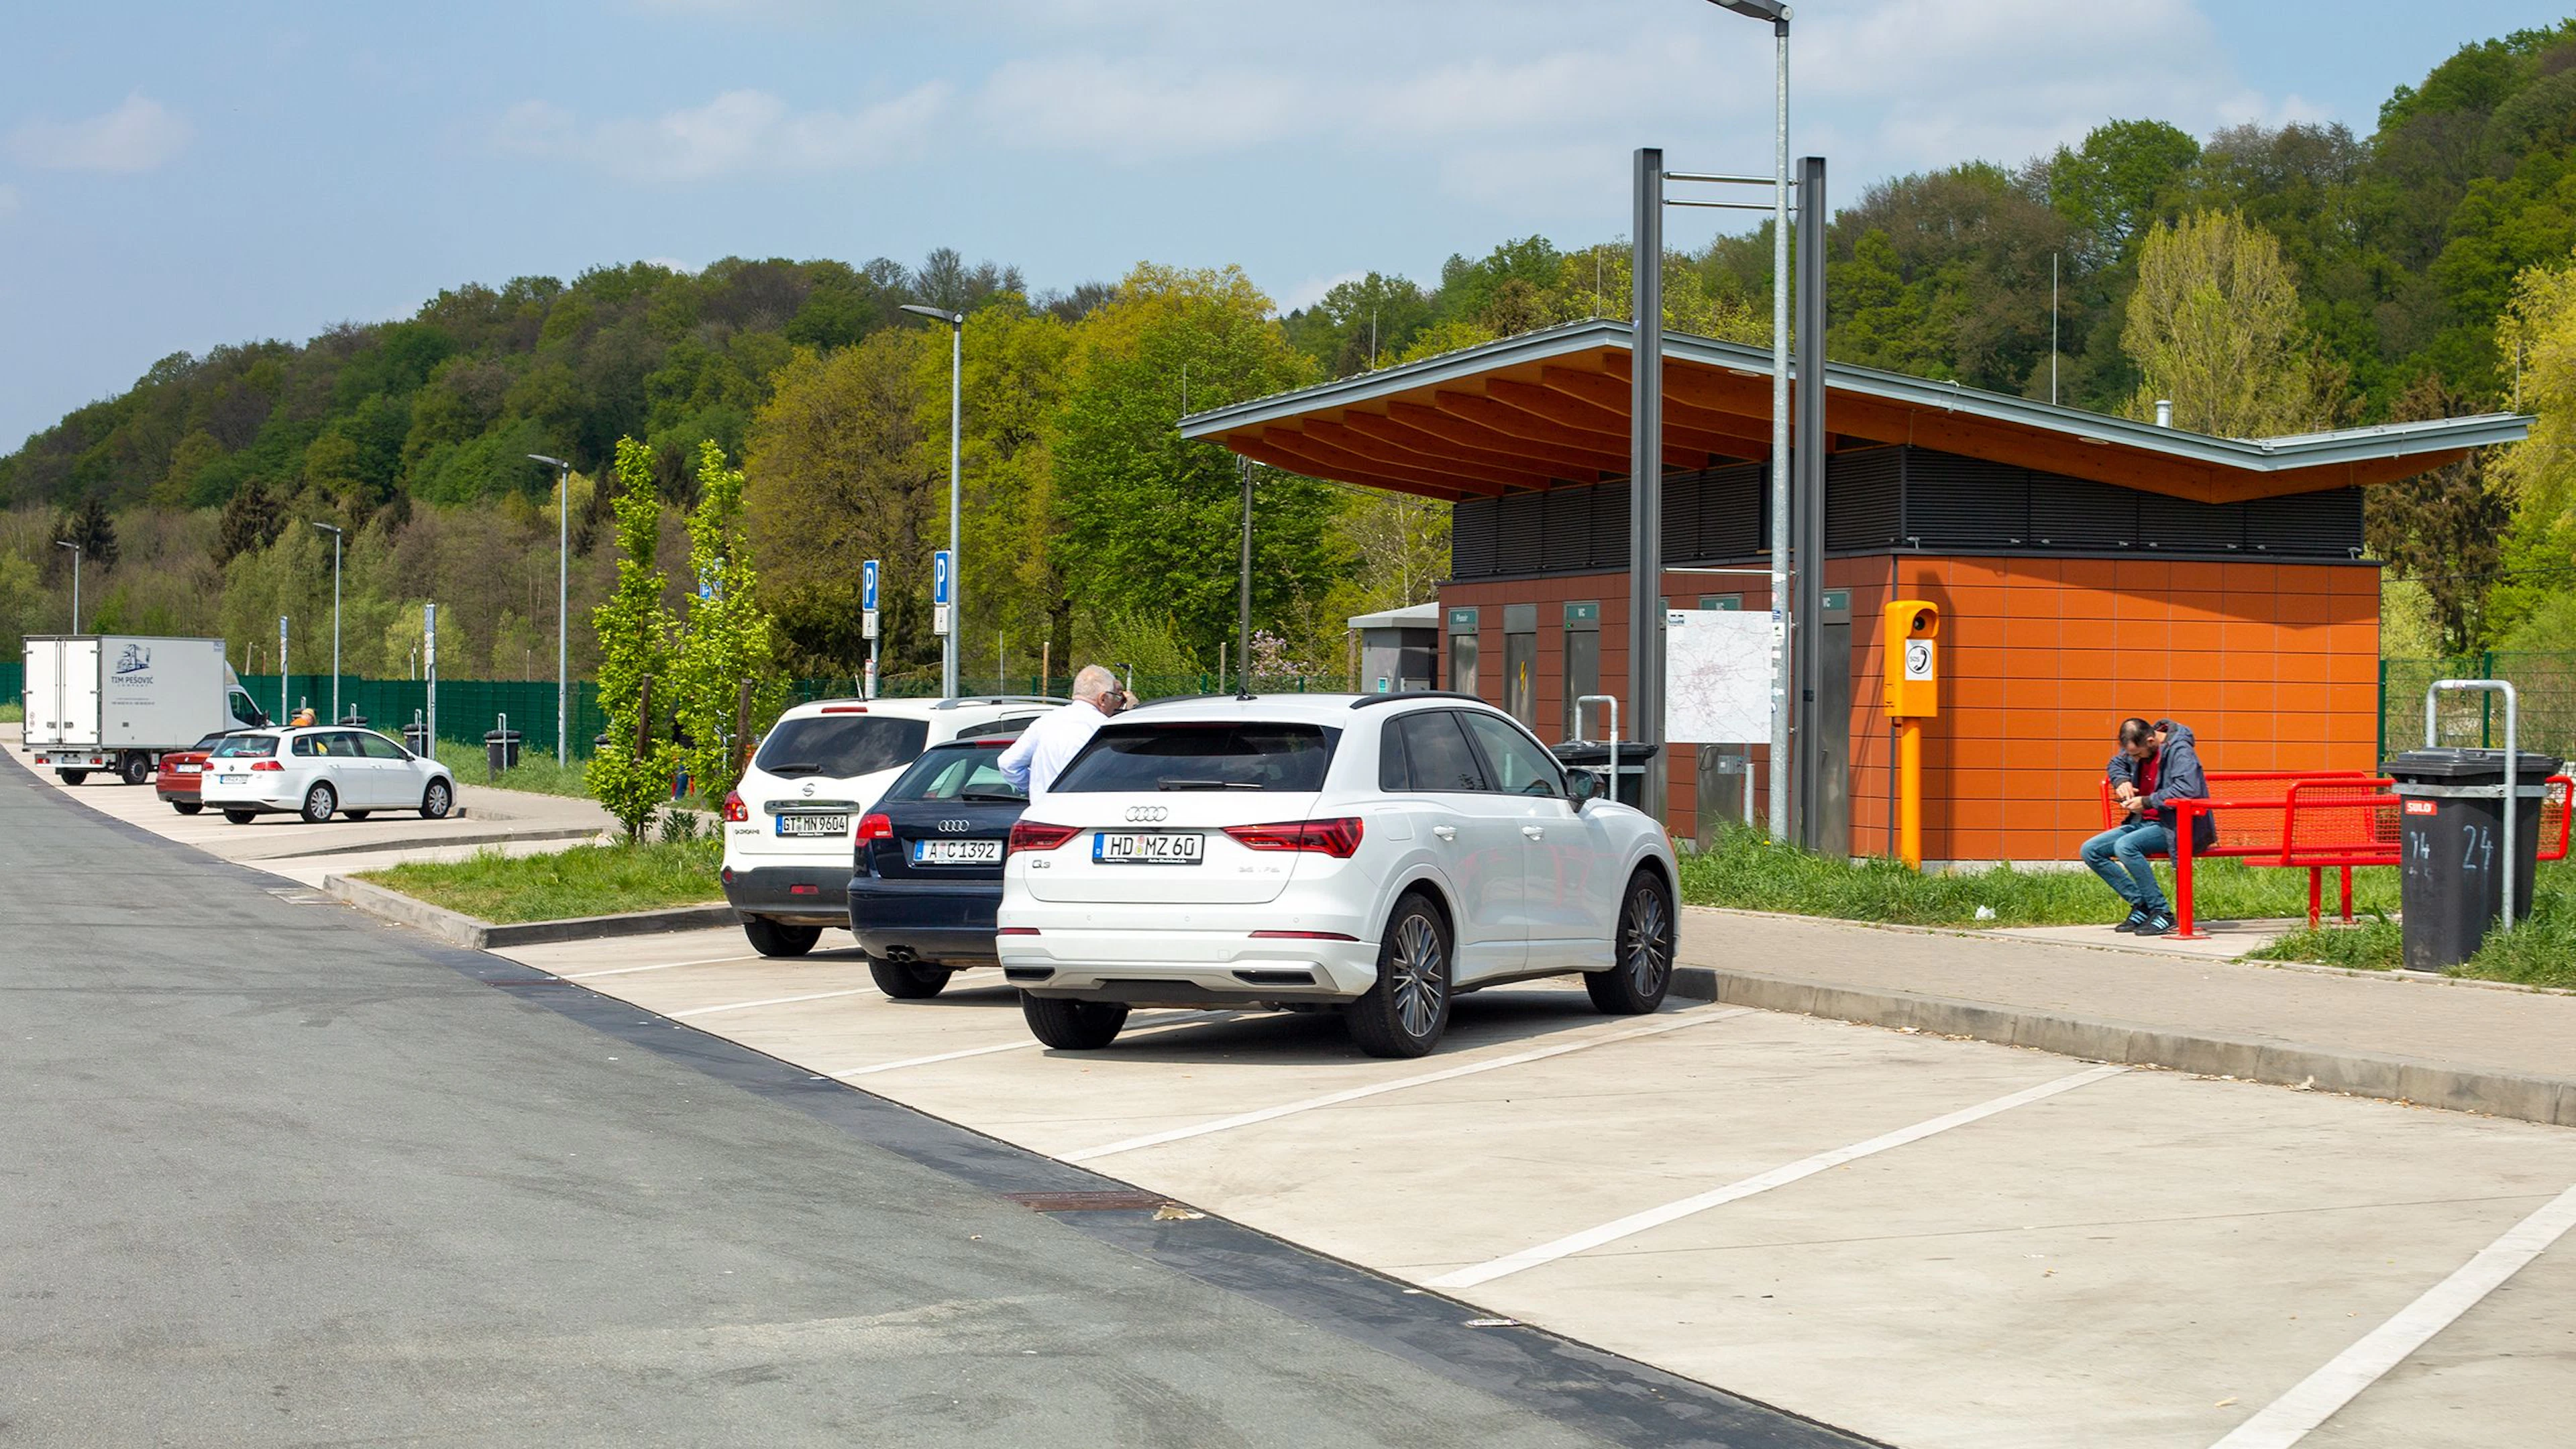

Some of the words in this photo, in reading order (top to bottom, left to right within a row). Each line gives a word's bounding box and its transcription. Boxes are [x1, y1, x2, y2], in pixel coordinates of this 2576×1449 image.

[865, 568, 873, 603] P
[937, 559, 945, 596] P
[784, 818, 795, 830] GT
[804, 818, 817, 830] MN
[820, 817, 845, 830] 9604
[928, 843, 937, 858] A
[1110, 837, 1133, 855] HD
[1145, 837, 1168, 855] MZ
[1173, 837, 1194, 855] 60
[2463, 824, 2493, 870] 24
[1032, 859, 1051, 869] Q3
